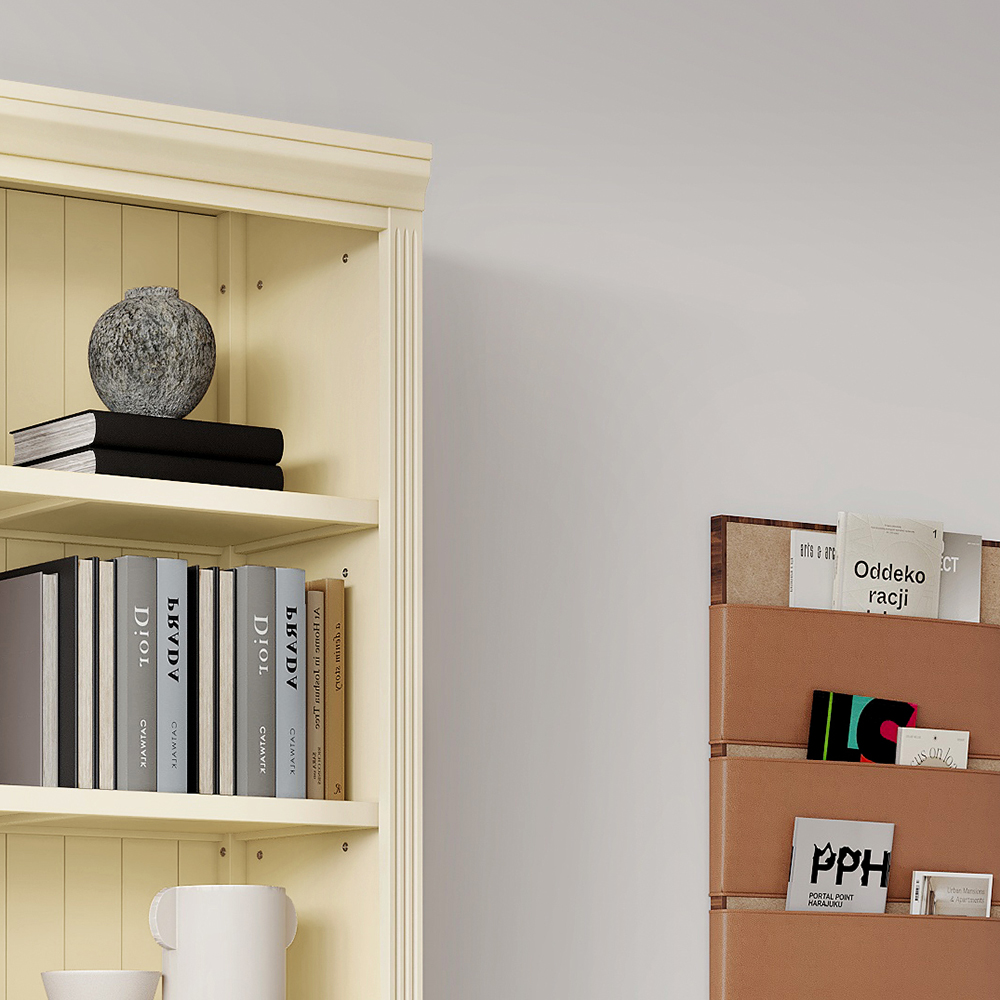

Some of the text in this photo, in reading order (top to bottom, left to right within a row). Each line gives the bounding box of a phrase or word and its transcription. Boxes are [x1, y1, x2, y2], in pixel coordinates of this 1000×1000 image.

[932, 529, 938, 539] 1
[800, 542, 814, 558] arts
[854, 560, 926, 584] Oddeko
[869, 588, 909, 610] racji
[929, 747, 943, 760] on
[810, 842, 891, 888] PPH
[809, 892, 854, 901] PORTAL POINT
[808, 900, 843, 908] HARAJUKU
